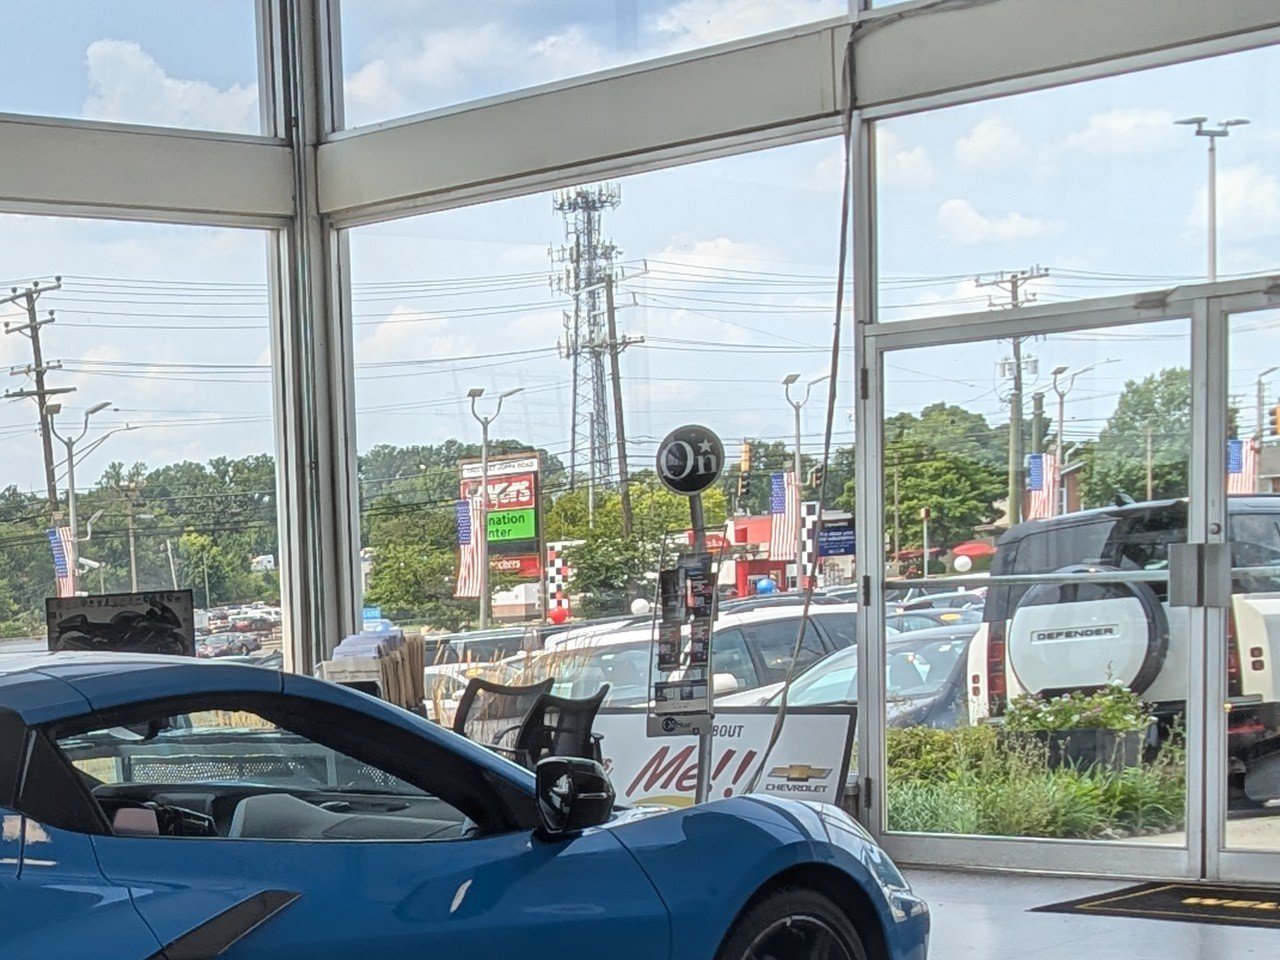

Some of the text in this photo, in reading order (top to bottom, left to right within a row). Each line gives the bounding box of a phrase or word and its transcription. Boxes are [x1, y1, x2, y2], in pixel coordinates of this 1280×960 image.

[660, 440, 718, 480] On
[488, 513, 526, 526] nation
[488, 528, 512, 538] nter
[1037, 628, 1113, 640] DEFENDER
[713, 724, 745, 739] BOUT
[765, 784, 829, 794] CHEVROLET
